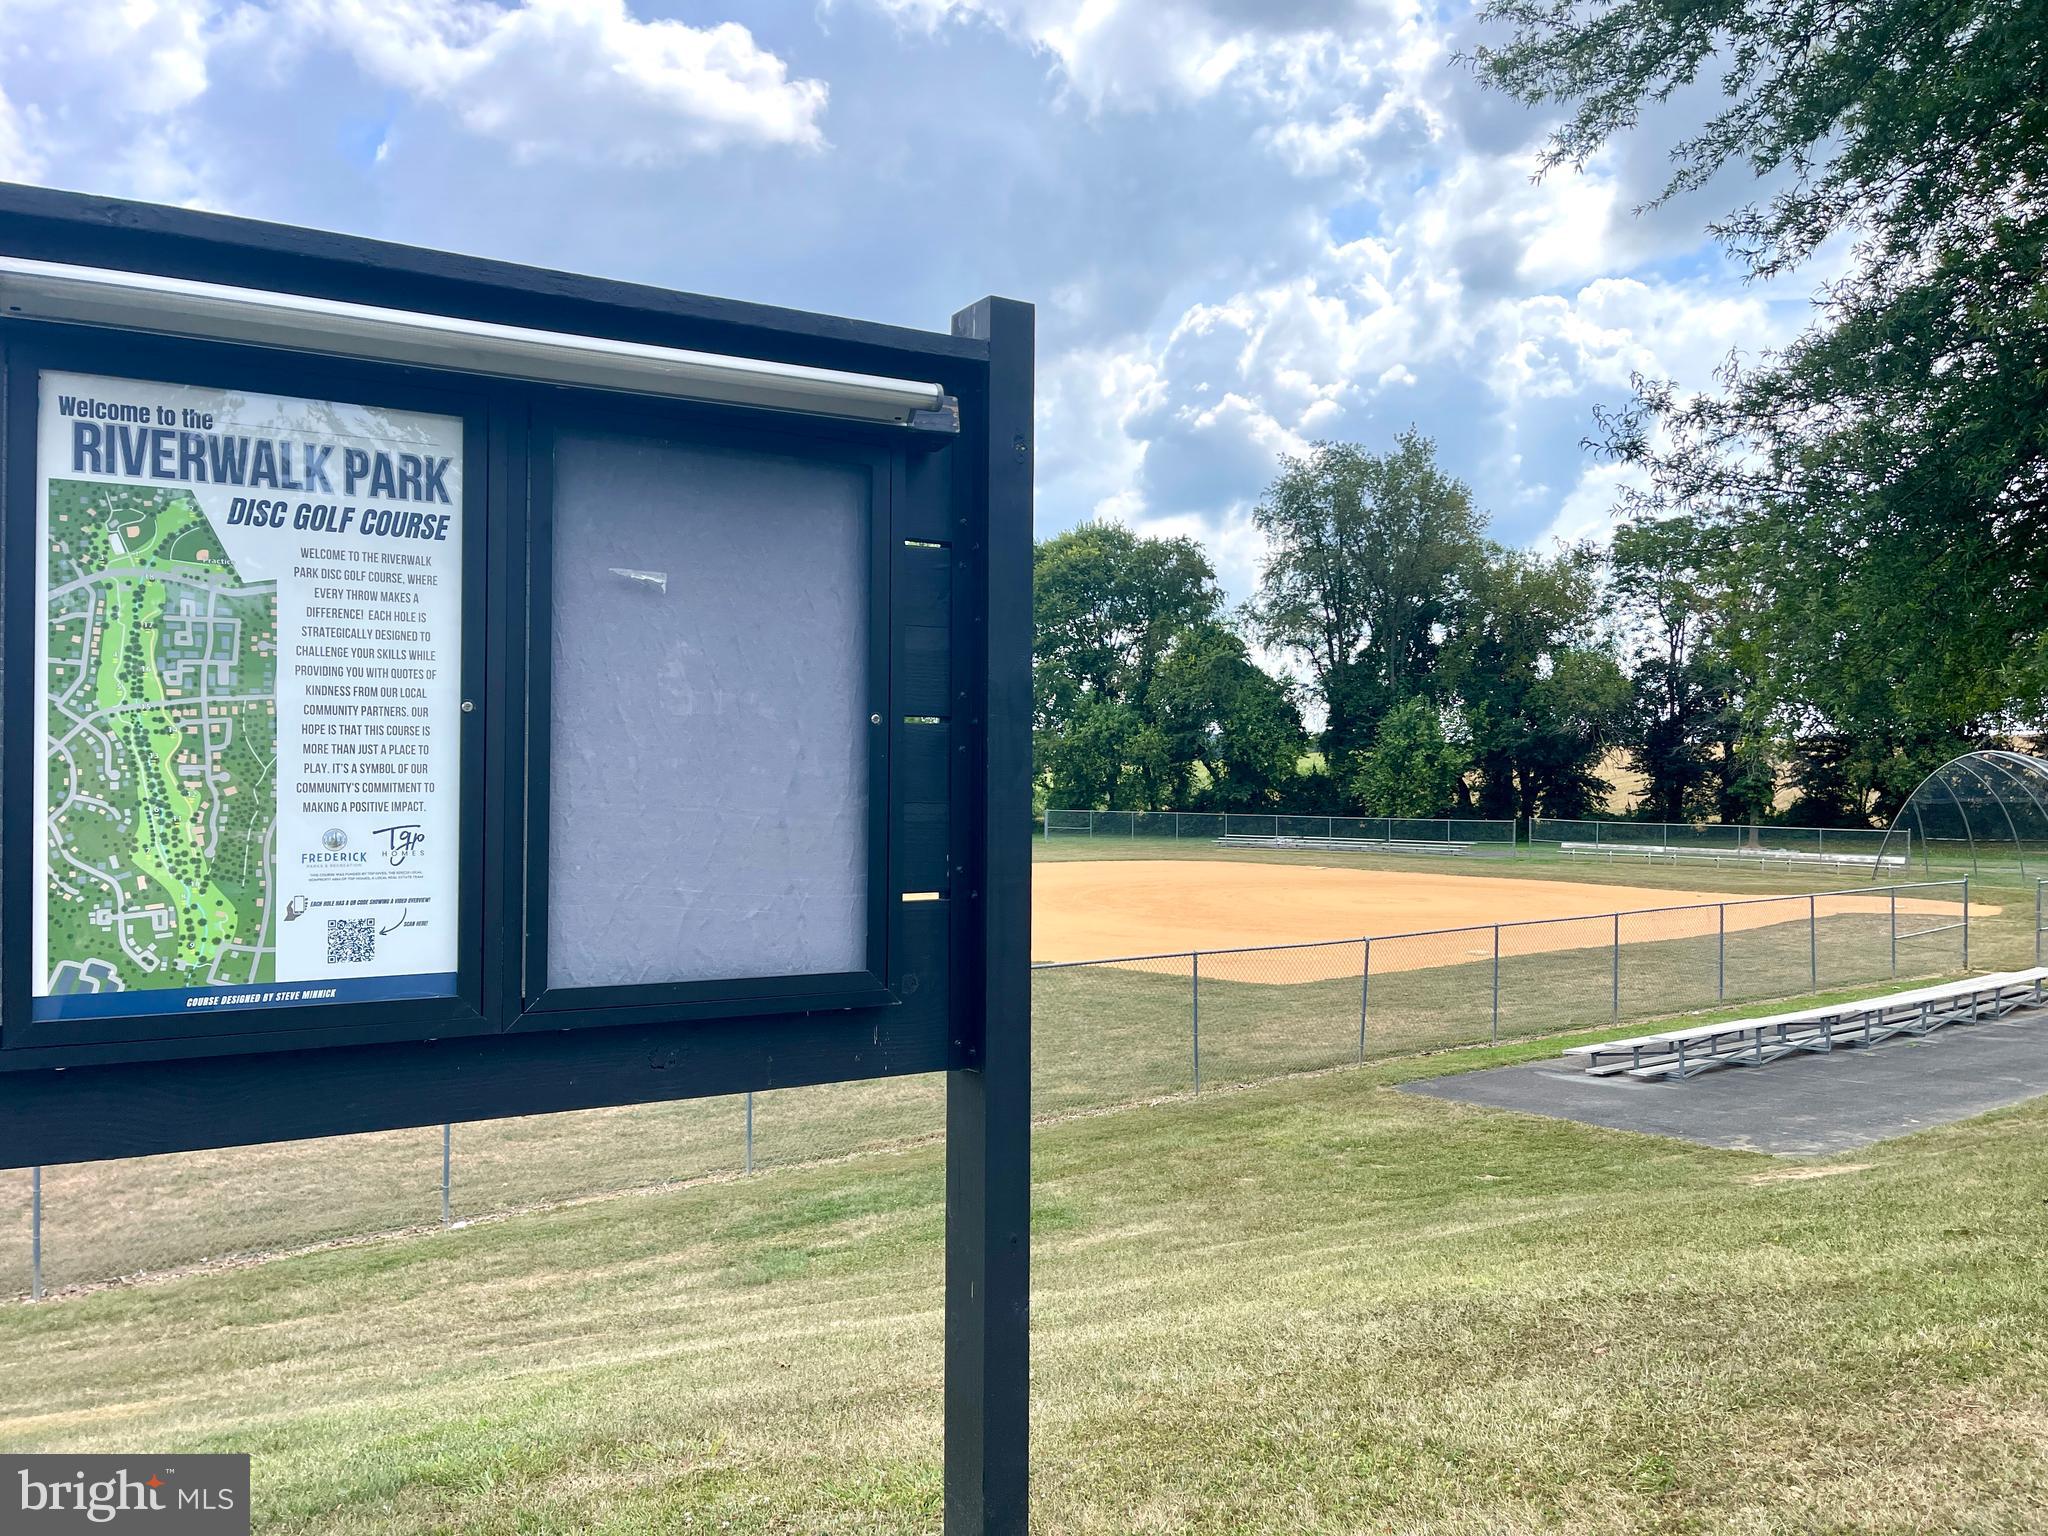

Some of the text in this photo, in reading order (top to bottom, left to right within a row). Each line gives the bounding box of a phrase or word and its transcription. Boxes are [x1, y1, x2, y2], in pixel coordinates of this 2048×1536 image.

[58, 395, 213, 429] Welcome to the
[71, 419, 454, 506] RIVERWALK PARK
[227, 497, 450, 540] DISC GOLF COURSE
[300, 547, 432, 566] WELCOME TO THE RIVERWALK
[294, 567, 438, 586] PARK DISC GOLF COURSE, WHERE
[314, 588, 419, 603] EVERY THROW MAKES A
[306, 607, 426, 622] DIFFERENCE! EACH HOLE IS
[301, 626, 430, 642] STRATEGICALLY DESIGNED TO
[296, 646, 436, 661] CHALLENGE YOUR SKILLS WHILE
[295, 665, 437, 679] PROVIDING YOU WITH QUOTES OF
[305, 685, 427, 698] KINDNESS FROM OUR LOCAL
[304, 705, 429, 717] COMMUNITY PARTNERS. OUR
[302, 724, 430, 736] HOPE IS THAT THIS COURSE IS
[303, 744, 429, 755] MORE THAN JUST A PLACE TO
[304, 763, 428, 774] PLAY. IT'S A SYMBOL OF OUR
[296, 783, 435, 793] COMMUNITY'S COMMITMENT TO
[303, 802, 426, 812] MAKING A POSITIVE IMPACT.
[302, 852, 367, 864] FREDERICK
[186, 989, 337, 1007] COURSE DESIGNED BY STEVE MINNICK
